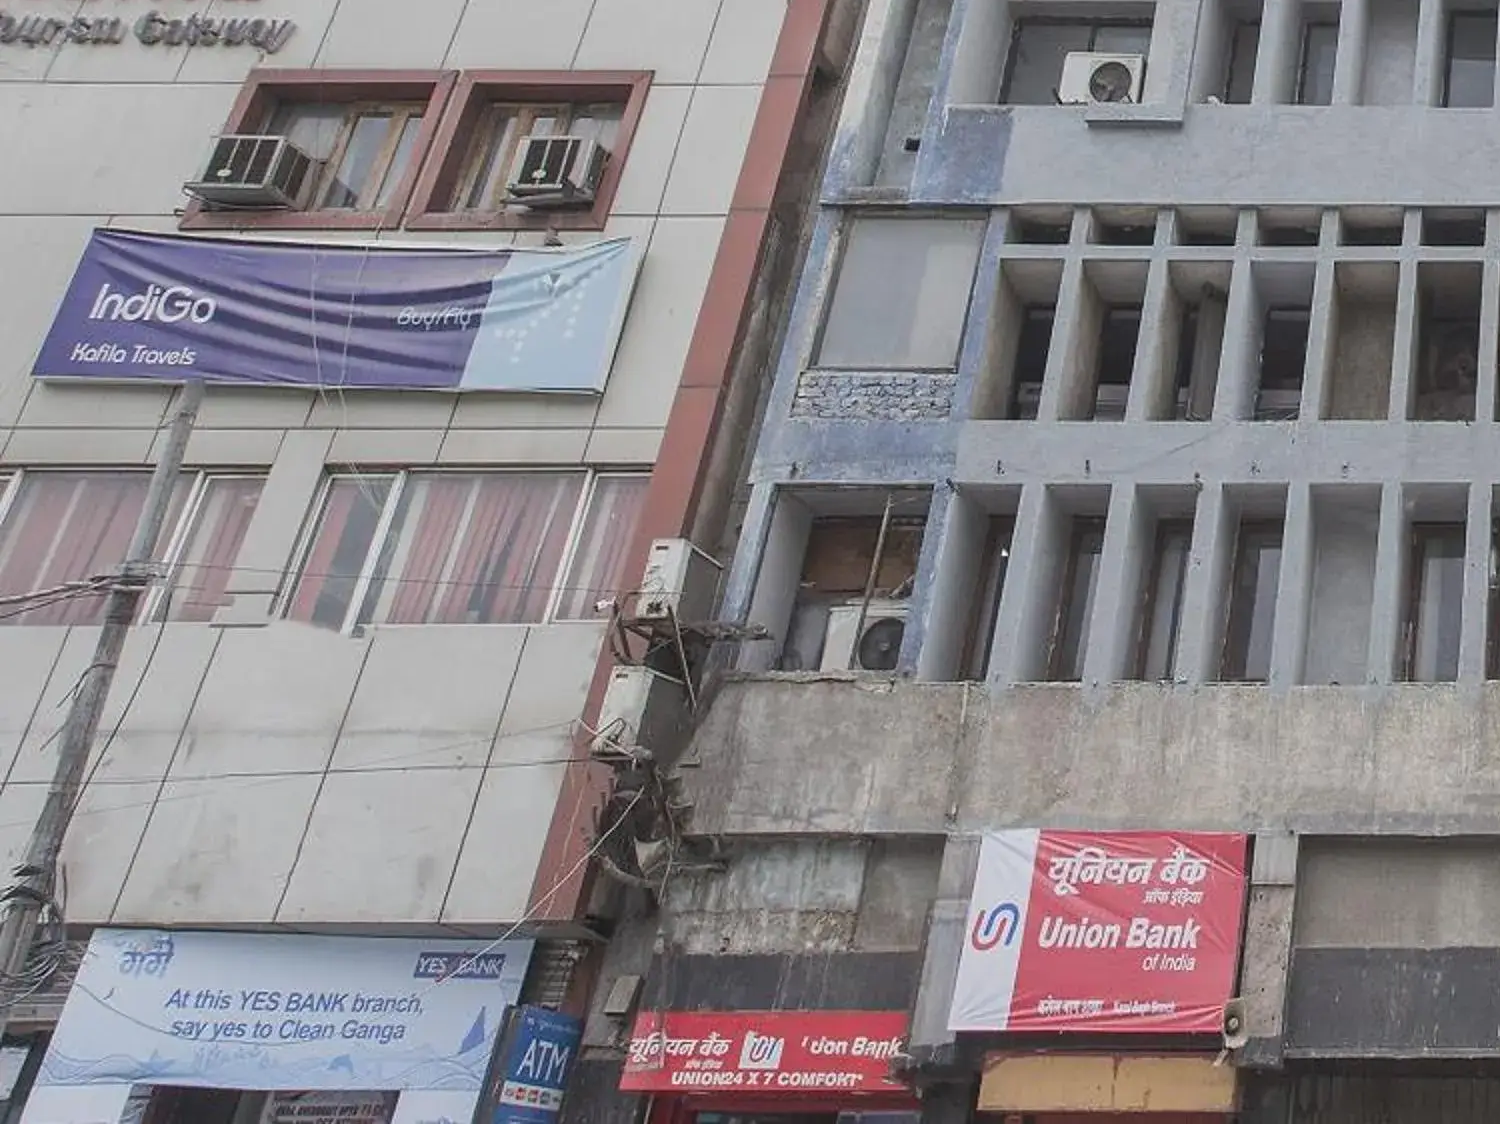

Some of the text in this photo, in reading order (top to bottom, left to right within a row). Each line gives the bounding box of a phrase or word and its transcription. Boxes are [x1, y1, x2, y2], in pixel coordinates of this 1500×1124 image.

[88, 283, 217, 323] IndiGo
[70, 342, 197, 365] Kafila Travels
[1048, 845, 1210, 896] यूनियन बैंक
[1038, 916, 1201, 949] Union Bank
[418, 956, 503, 975] YES BANK
[1142, 954, 1195, 971] of India
[164, 988, 425, 1015] At this YES BANK branch,
[170, 1020, 406, 1044] say yes to Clean Ganga
[515, 1038, 571, 1084] ATM
[763, 1072, 773, 1085] 7
